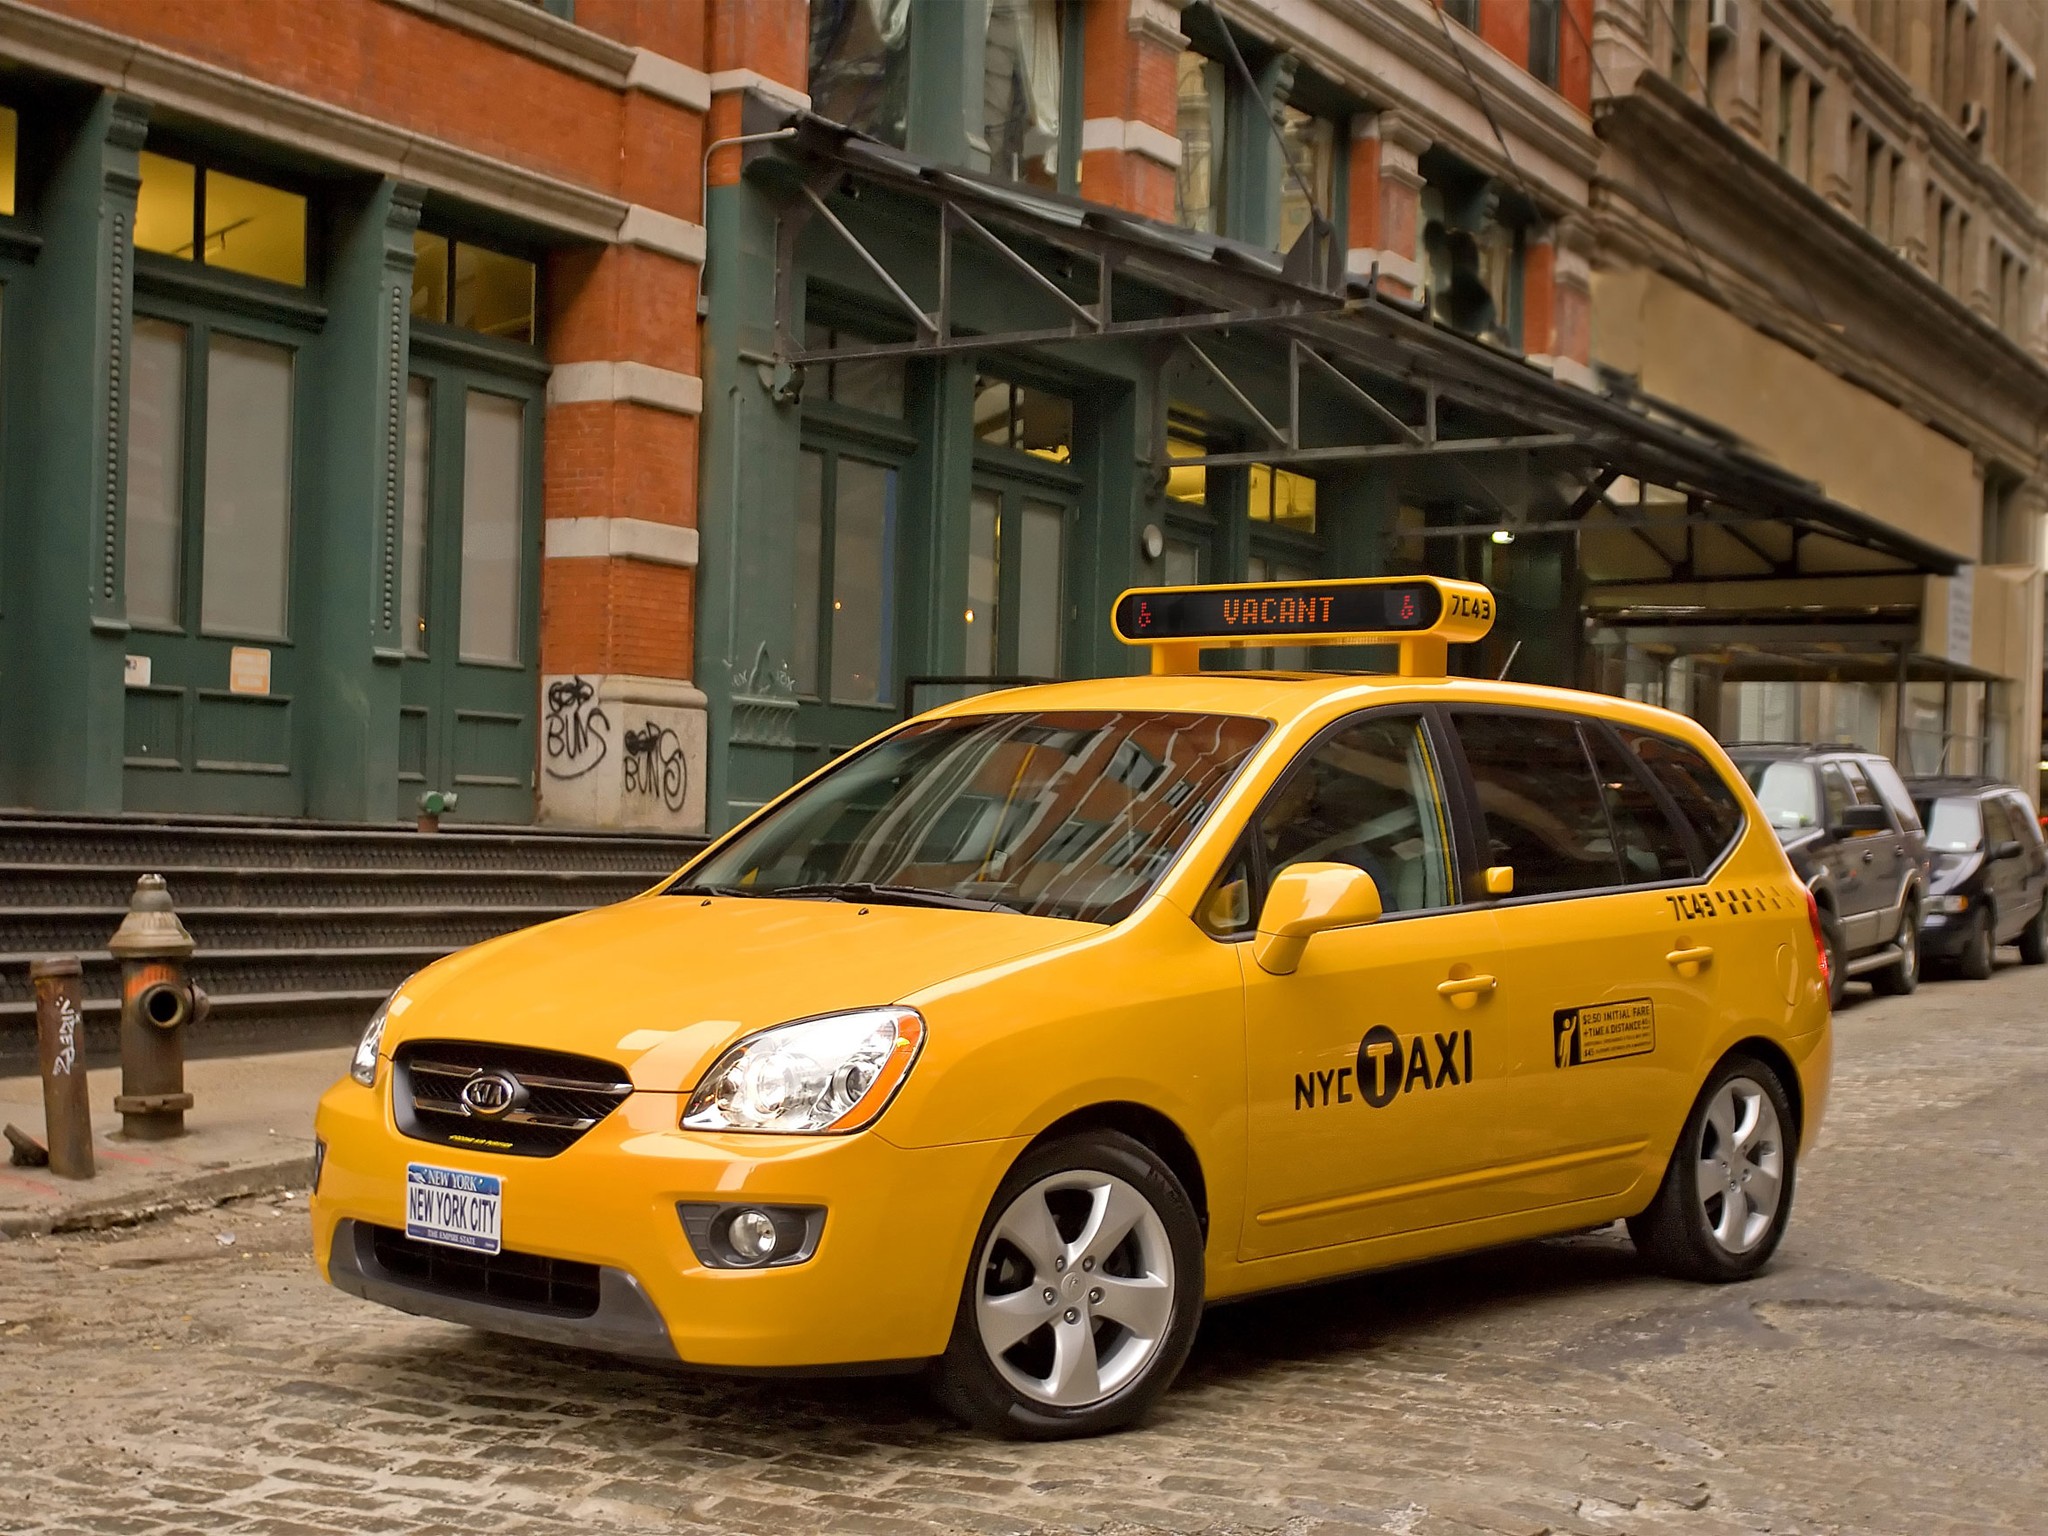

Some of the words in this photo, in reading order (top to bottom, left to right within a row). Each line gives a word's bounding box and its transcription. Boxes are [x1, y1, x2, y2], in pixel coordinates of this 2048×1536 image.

[1223, 596, 1334, 625] VACANT
[1604, 1009, 1630, 1020] INITIAL
[1633, 1006, 1649, 1016] FARE
[1295, 1068, 1353, 1110] NYC
[1364, 1028, 1473, 1098] TAXI
[428, 1169, 450, 1187] NEW
[451, 1173, 477, 1191] YORK
[410, 1187, 434, 1222] NEW
[437, 1191, 467, 1229] YORK
[470, 1198, 496, 1234] CITY
[459, 1235, 476, 1246] STATE
